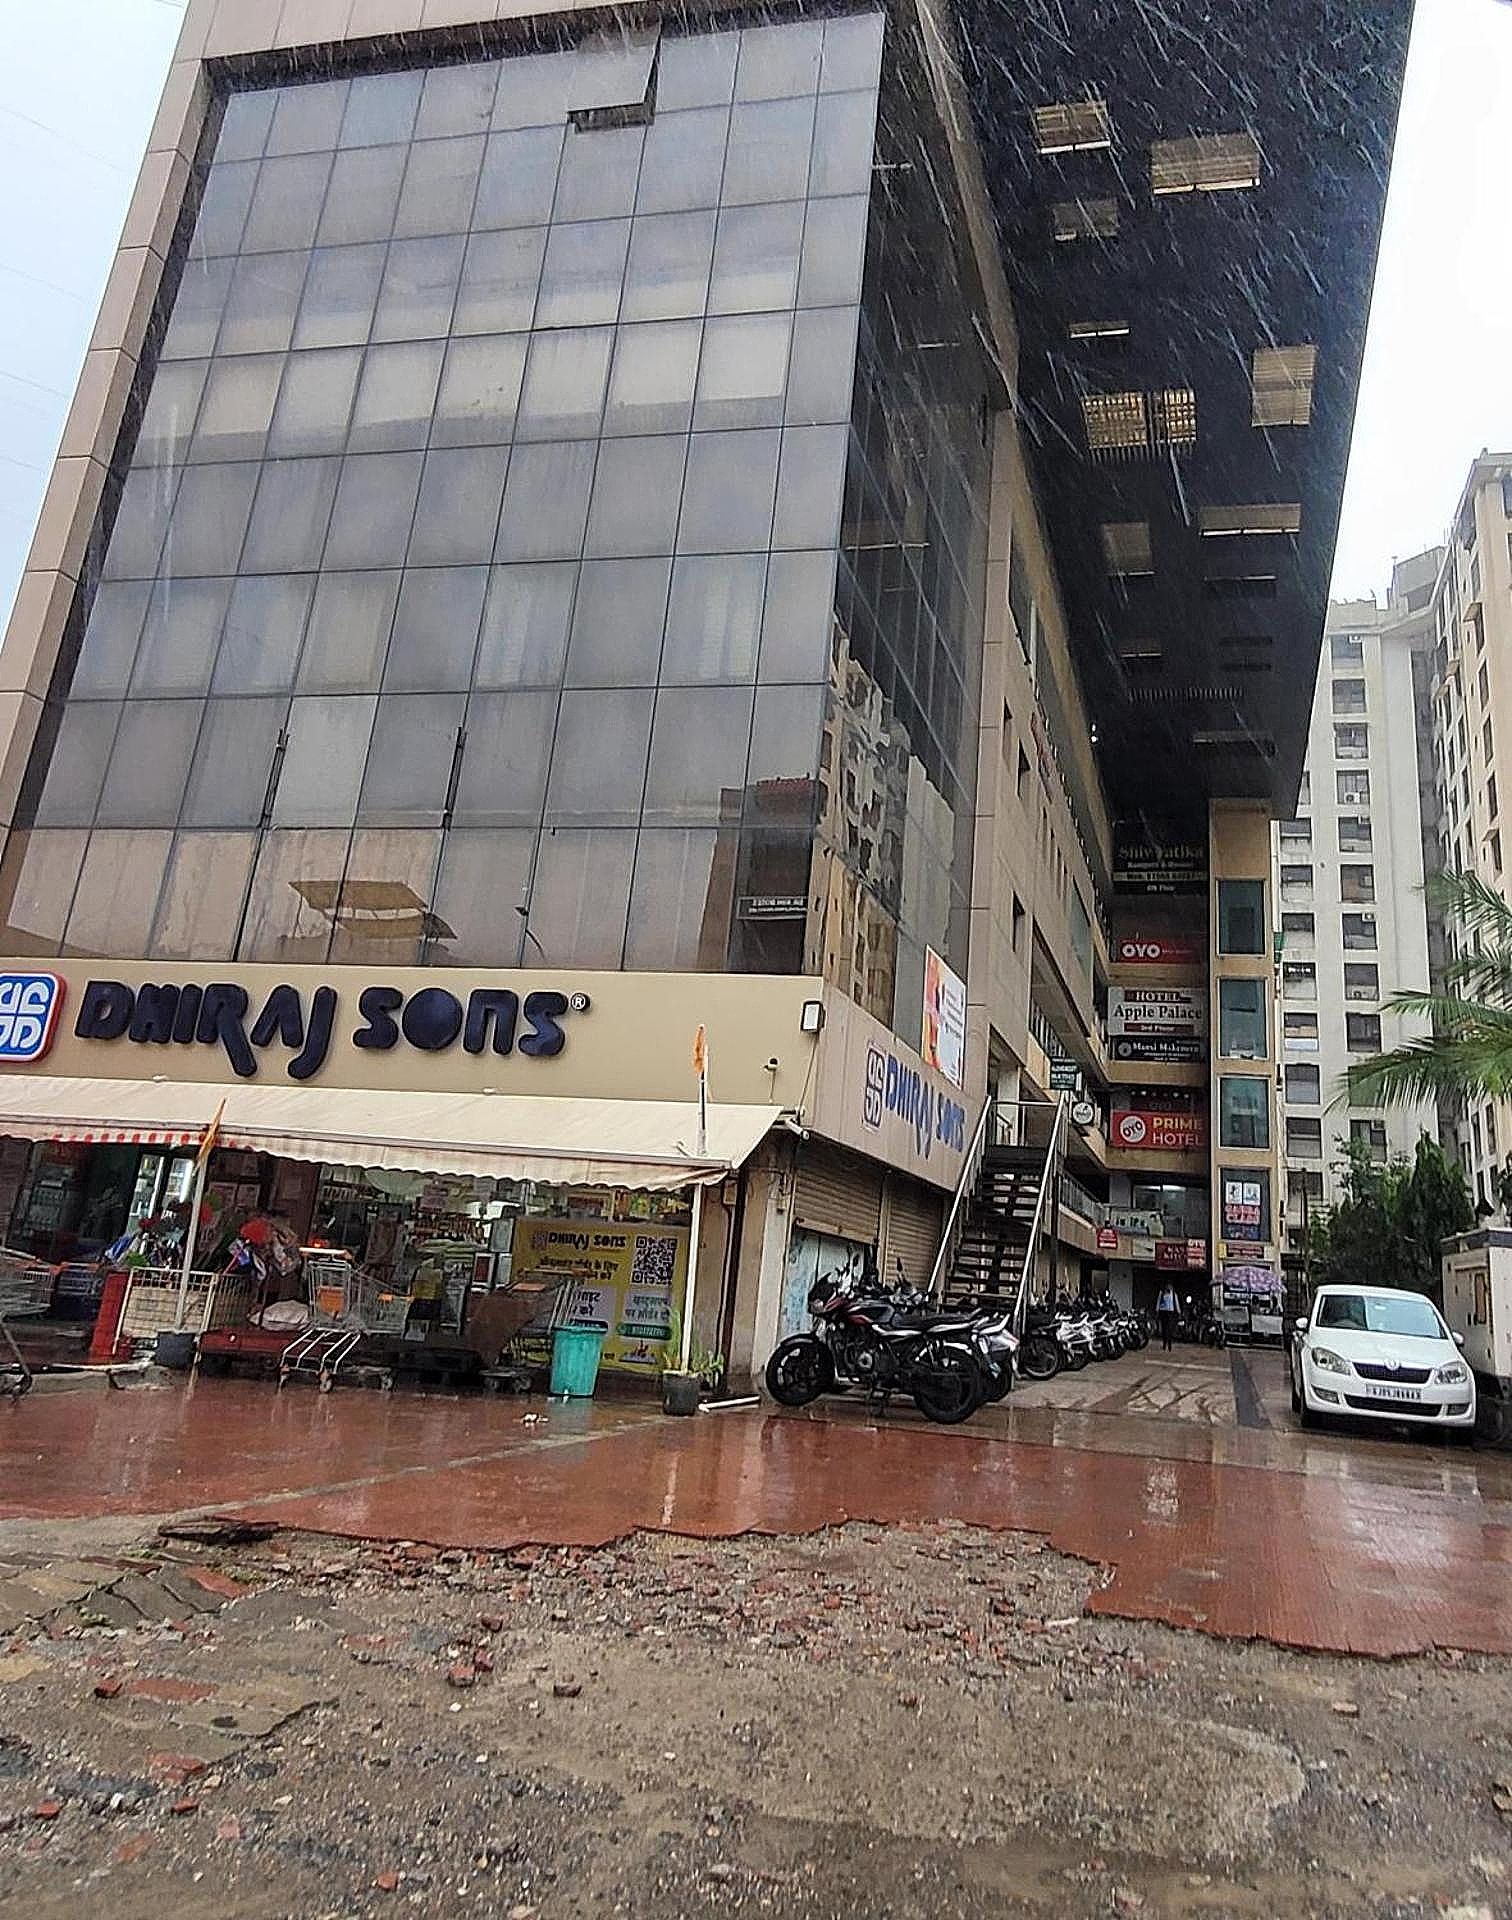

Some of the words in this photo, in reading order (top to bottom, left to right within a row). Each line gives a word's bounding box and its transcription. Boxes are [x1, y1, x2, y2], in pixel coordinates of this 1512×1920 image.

[1122, 943, 1160, 958] OYO
[1135, 991, 1180, 1002] HOTEL
[1113, 1004, 1155, 1020] Apple
[1160, 1005, 1202, 1019] Palace
[75, 980, 338, 1079] DHIRAJ
[886, 1054, 934, 1160] DHIRAJ
[1122, 1121, 1143, 1137] OYO
[1153, 1117, 1202, 1131] PRIME
[1153, 1132, 1202, 1146] HOTEL
[549, 1231, 589, 1251] DHIRAJ
